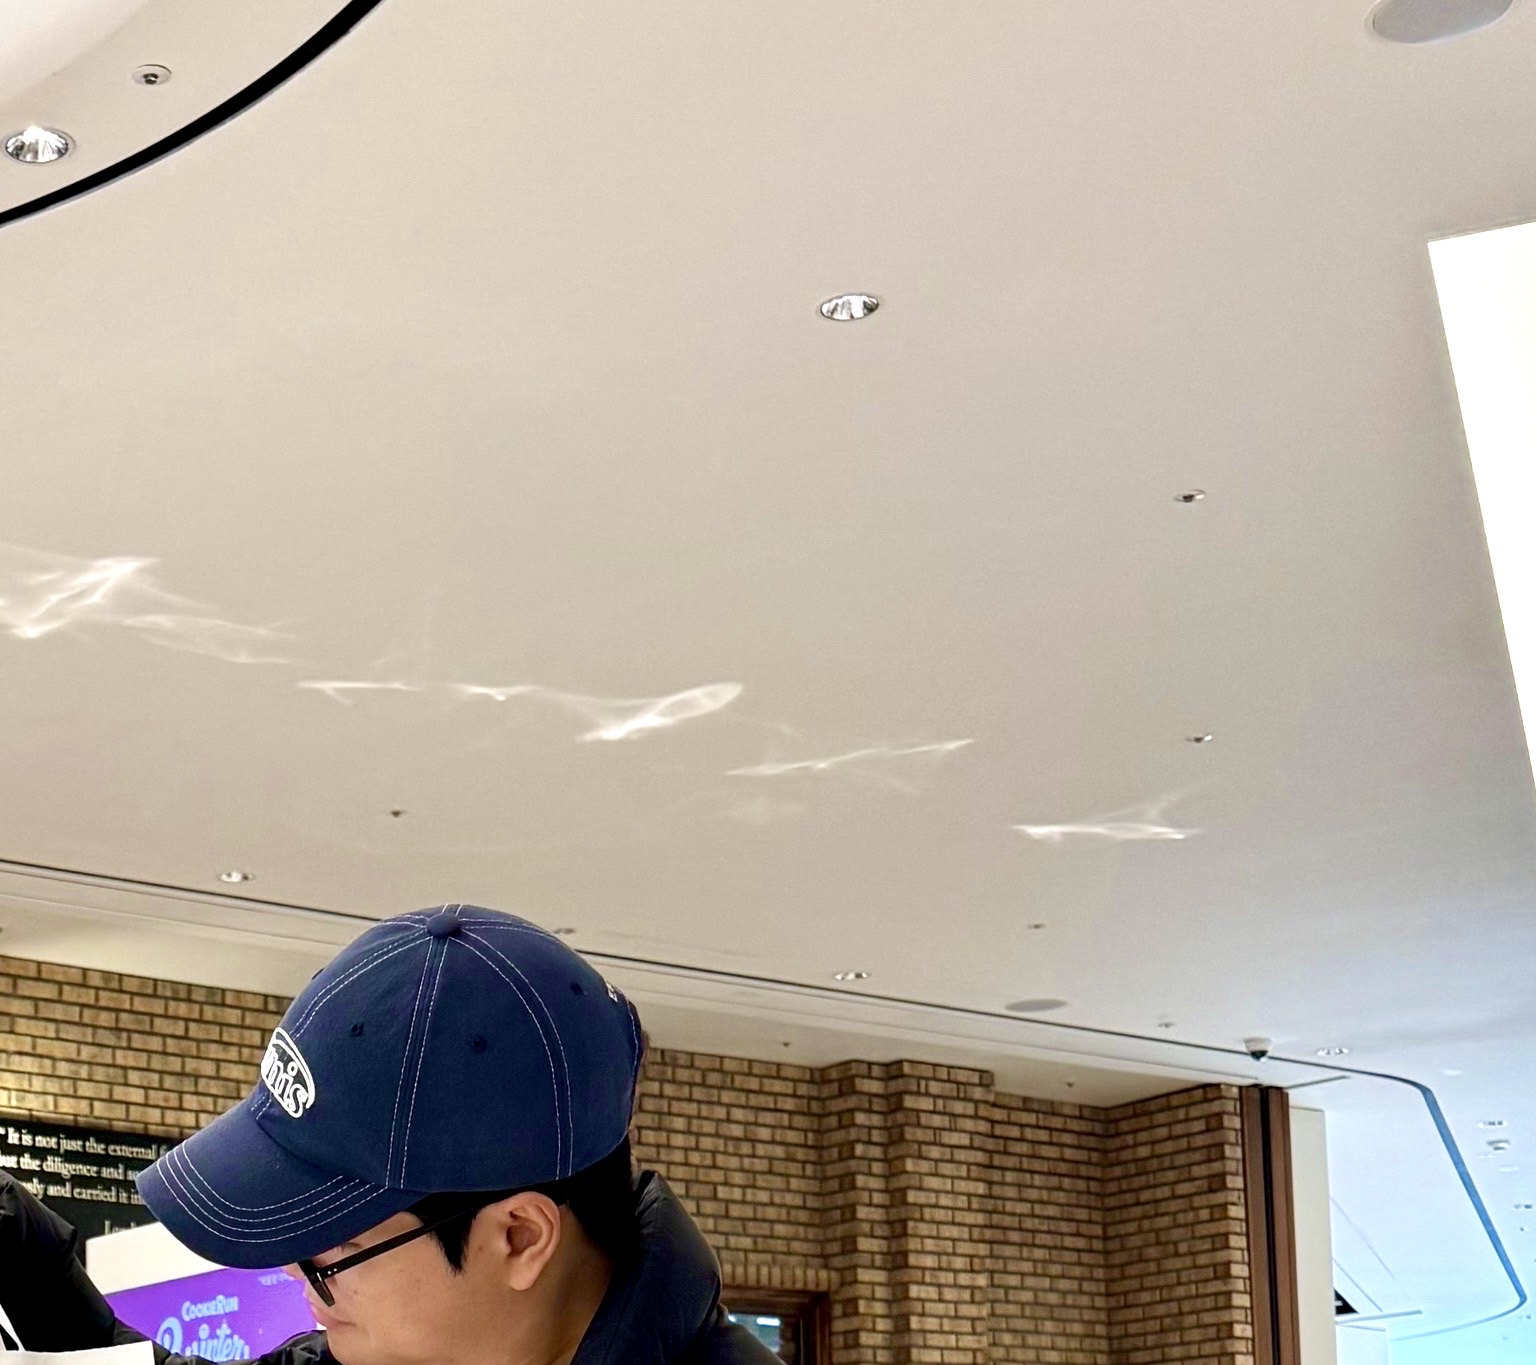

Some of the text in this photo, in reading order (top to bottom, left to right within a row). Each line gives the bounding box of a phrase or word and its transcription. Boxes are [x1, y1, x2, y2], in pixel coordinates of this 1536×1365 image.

[21, 1128, 33, 1146] is
[35, 1135, 58, 1149] not
[59, 1133, 83, 1154] just
[85, 1136, 106, 1154] the
[108, 1144, 157, 1160] external
[20, 1152, 41, 1171] the
[43, 1155, 98, 1179] diligence
[101, 1163, 124, 1180] and
[46, 1182, 72, 1198] and
[73, 1185, 117, 1202] carried
[119, 1188, 129, 1204] it
